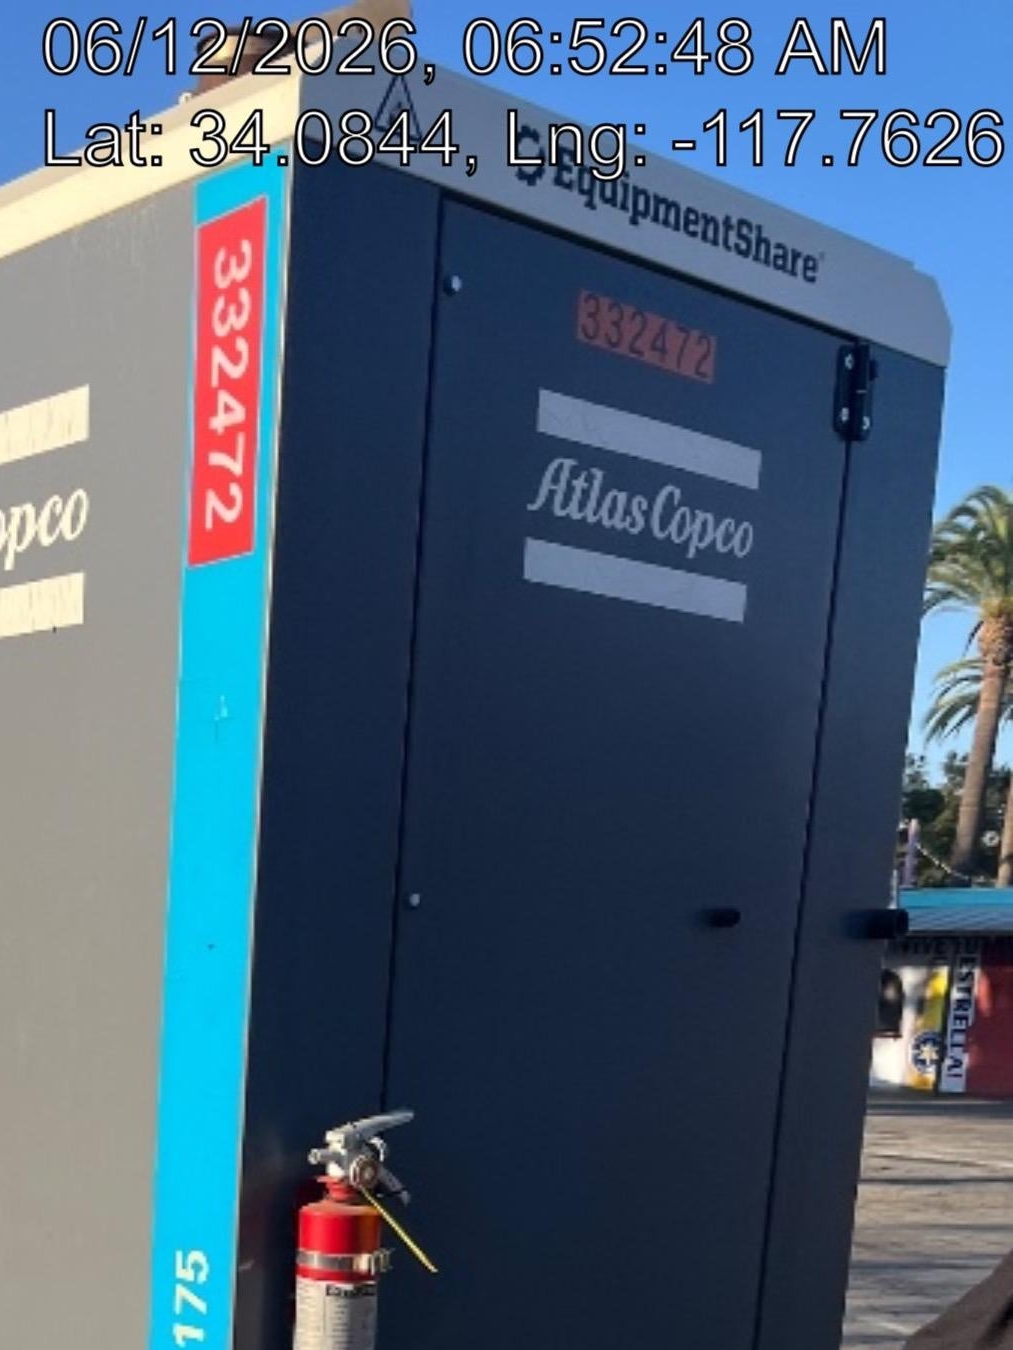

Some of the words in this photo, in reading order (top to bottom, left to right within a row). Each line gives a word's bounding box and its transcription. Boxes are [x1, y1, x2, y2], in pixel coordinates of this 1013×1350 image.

[553, 146, 821, 284] EquipmentShare
[204, 239, 253, 531] 332472
[581, 294, 713, 379] 332472
[526, 457, 649, 535] Atlas
[650, 484, 754, 559] Copco
[172, 1250, 210, 1348] 175
